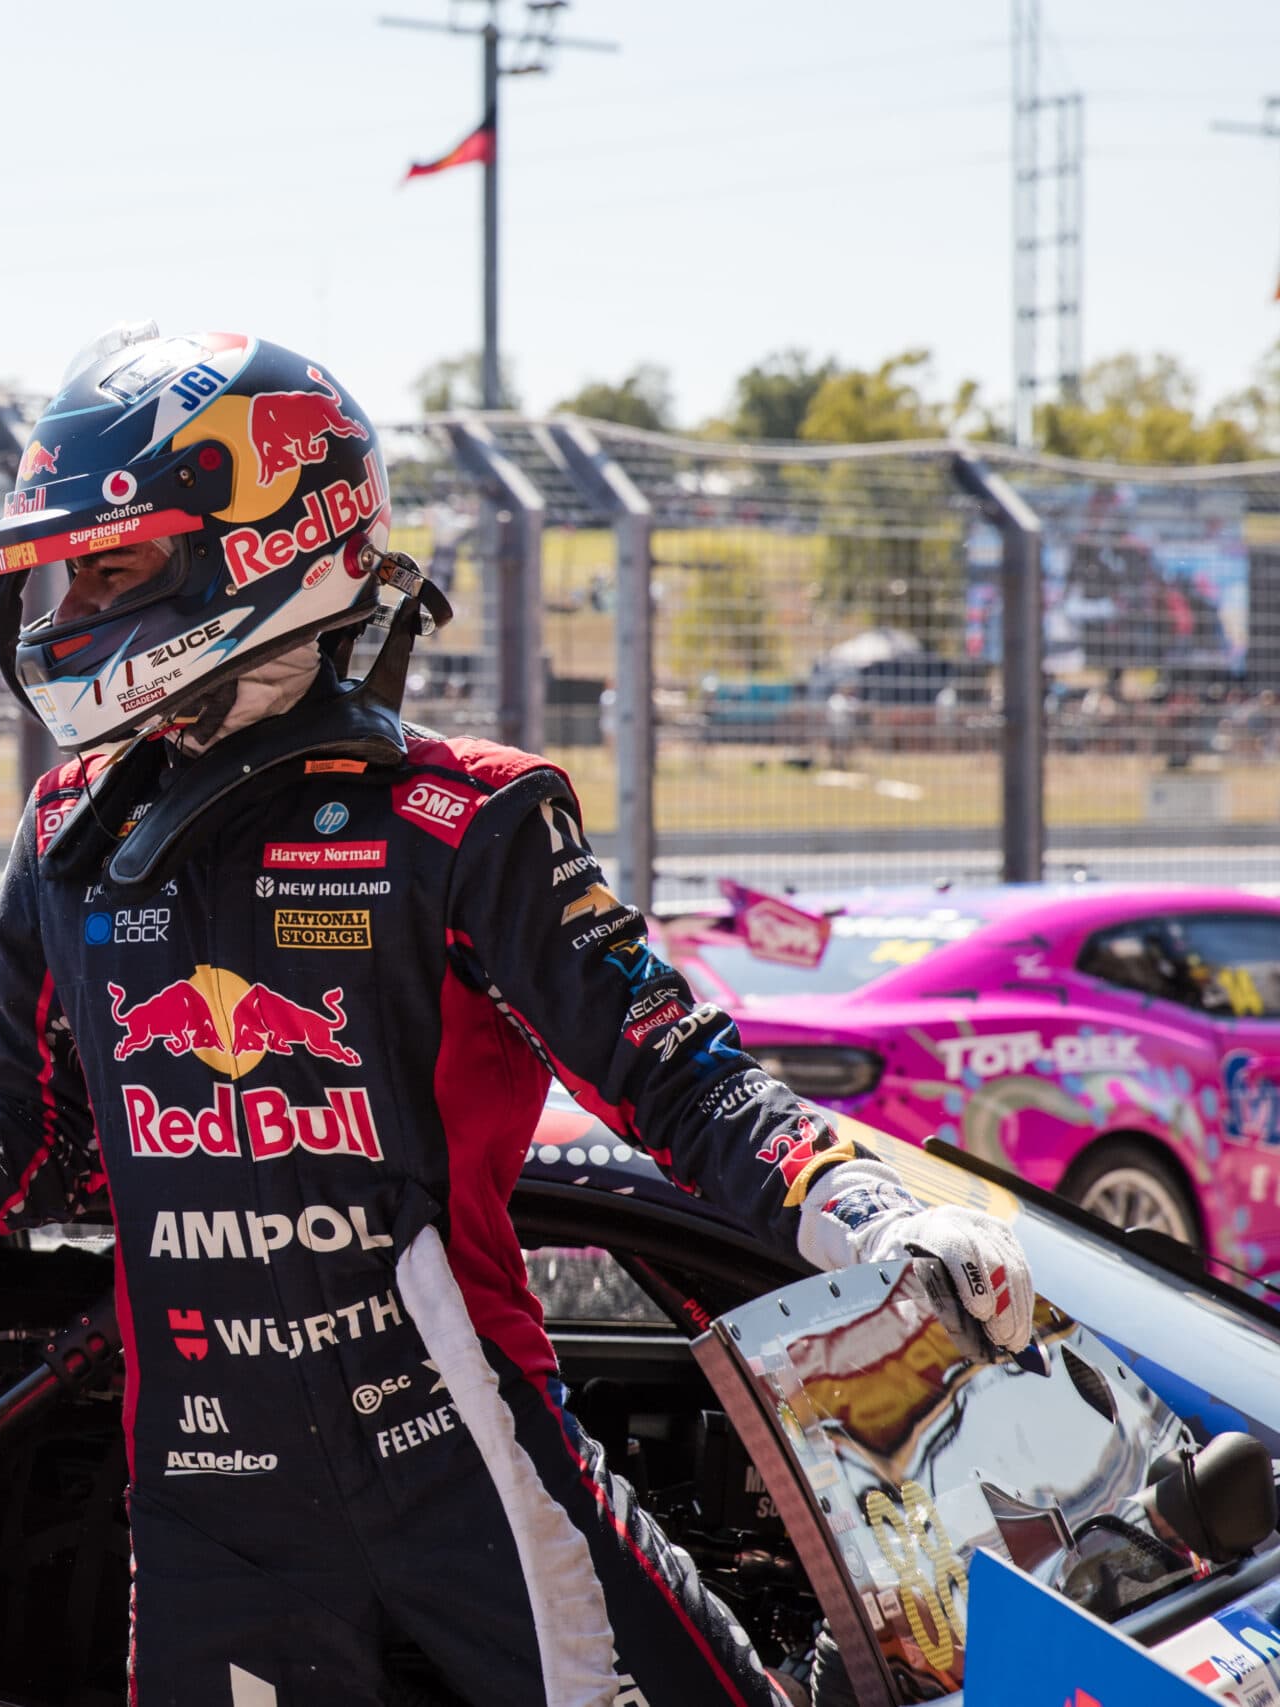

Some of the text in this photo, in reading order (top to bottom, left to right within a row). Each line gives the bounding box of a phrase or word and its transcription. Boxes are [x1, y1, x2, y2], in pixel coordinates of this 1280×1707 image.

[169, 362, 229, 412] JGI
[18, 487, 46, 515] Bull
[95, 502, 154, 523] vodafone
[69, 518, 140, 545] SUPERCHEAP
[221, 448, 386, 589] Red Bull
[4, 542, 38, 569] SUPER
[92, 537, 117, 547] AUTO
[305, 559, 331, 585] BELL
[146, 620, 225, 667] ZUCE
[116, 668, 183, 701] RECURVE
[124, 688, 165, 712] ACADEMY
[407, 787, 465, 821] OMP
[318, 803, 345, 833] hp
[270, 846, 380, 864] Harvey Norman
[278, 880, 391, 897] NEW HOLLAND
[115, 908, 170, 926] QUAD
[277, 911, 367, 927] NATIONAL
[114, 925, 169, 943] LOCK
[281, 930, 365, 945] STORAGE
[631, 1003, 680, 1041] ACADEMY
[121, 1081, 385, 1163] Red Bull
[149, 1204, 394, 1264] AMPOL
[966, 1262, 985, 1296] OMP
[179, 1395, 230, 1435] JGI
